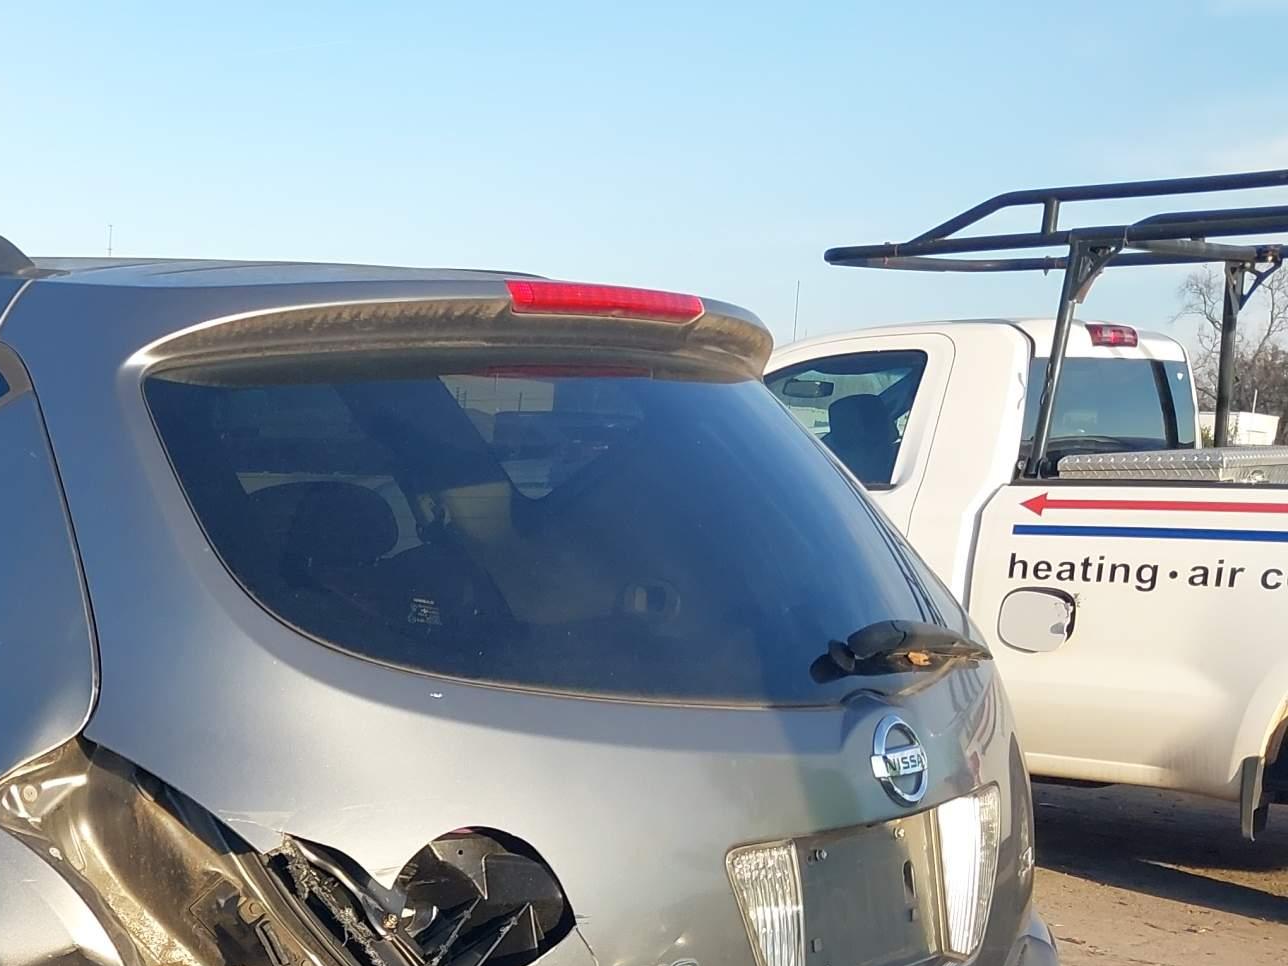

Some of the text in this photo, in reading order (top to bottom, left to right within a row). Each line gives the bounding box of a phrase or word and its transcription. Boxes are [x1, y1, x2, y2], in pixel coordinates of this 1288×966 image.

[1007, 552, 1288, 592] heating air c
